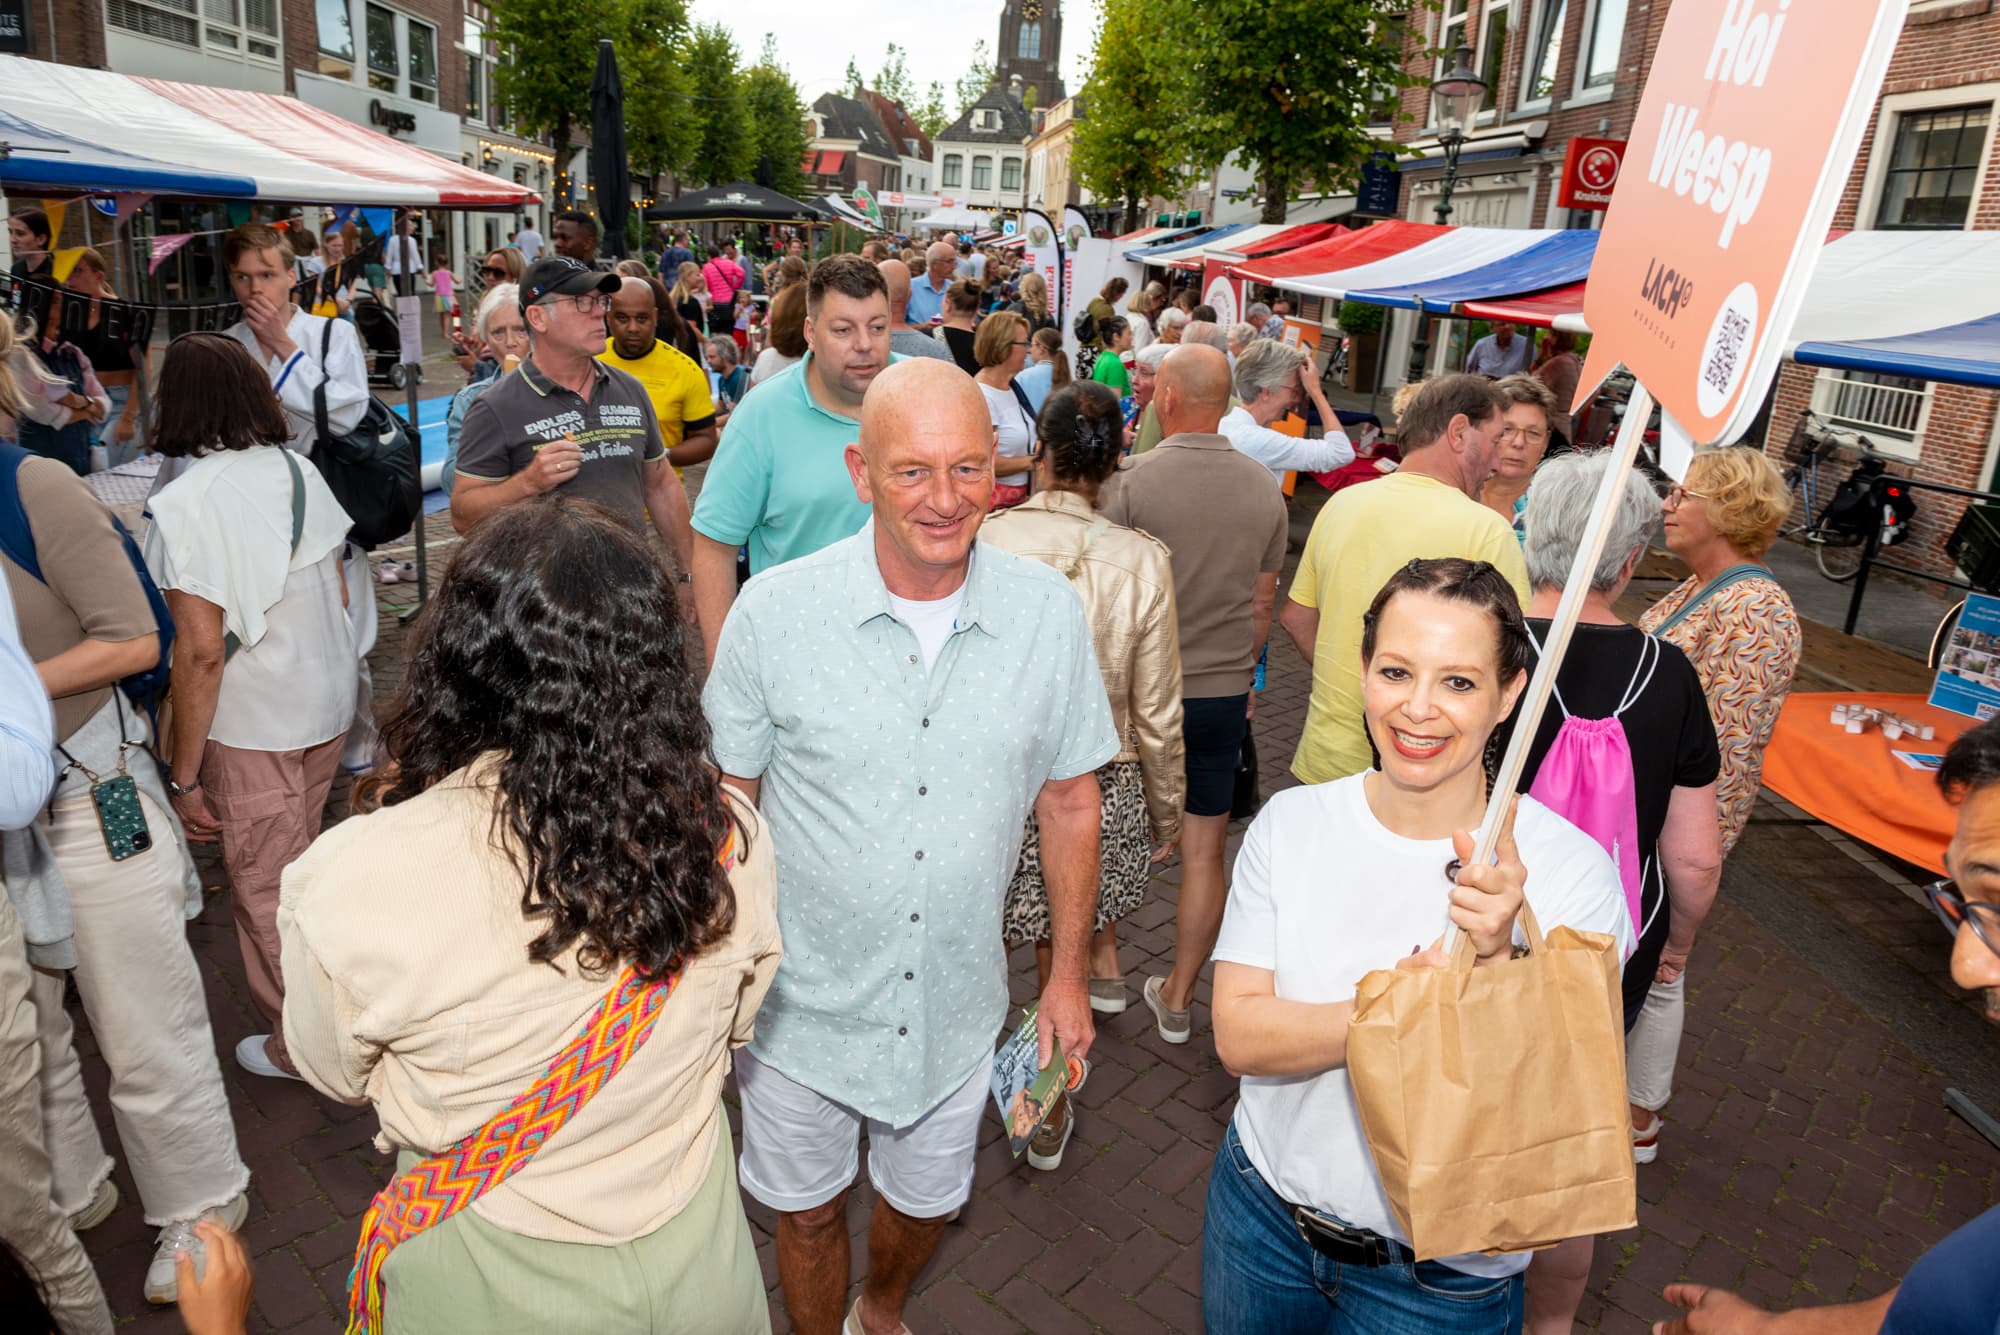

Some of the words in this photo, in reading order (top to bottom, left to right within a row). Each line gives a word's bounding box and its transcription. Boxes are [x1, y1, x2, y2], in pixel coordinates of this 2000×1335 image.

[1704, 0, 1792, 87] Hoi
[1648, 103, 1772, 249] Weesp
[1574, 189, 1612, 203] Kruidva
[598, 405, 642, 417] SUMMER
[600, 416, 641, 427] RESORT
[523, 410, 582, 435] ENDLESS
[540, 419, 587, 440] VACAY
